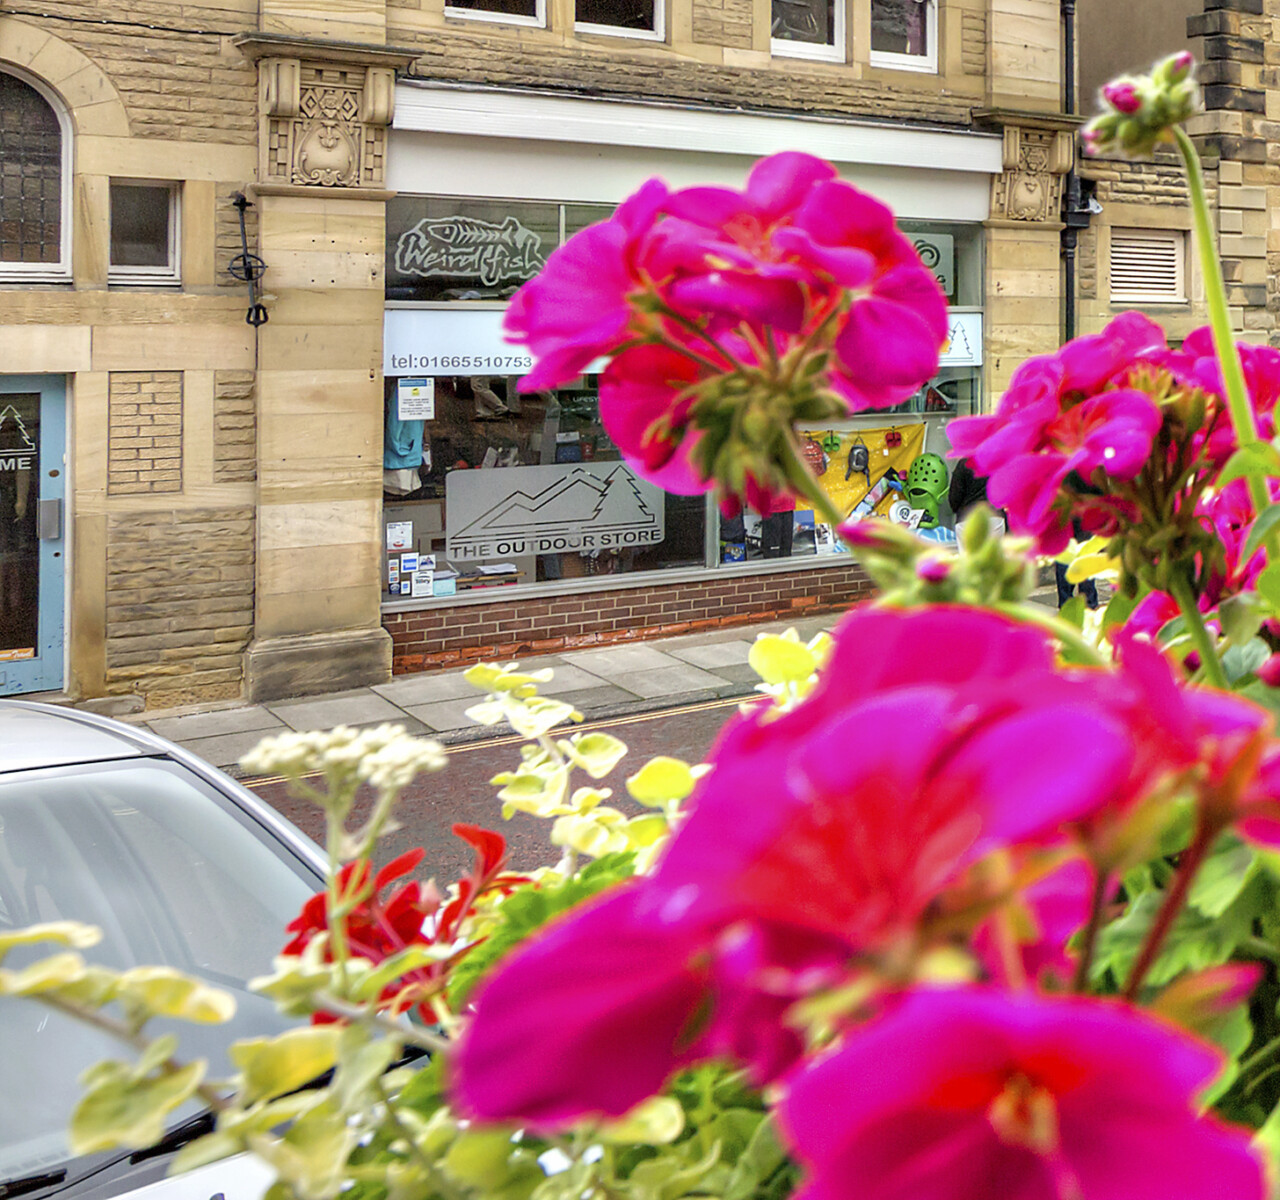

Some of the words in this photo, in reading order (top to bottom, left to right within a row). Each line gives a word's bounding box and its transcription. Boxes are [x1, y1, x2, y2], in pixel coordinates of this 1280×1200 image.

[404, 235, 482, 269] Weird
[450, 545, 490, 558] THE
[497, 535, 594, 554] OUTDOOR
[601, 529, 661, 545] STORE
